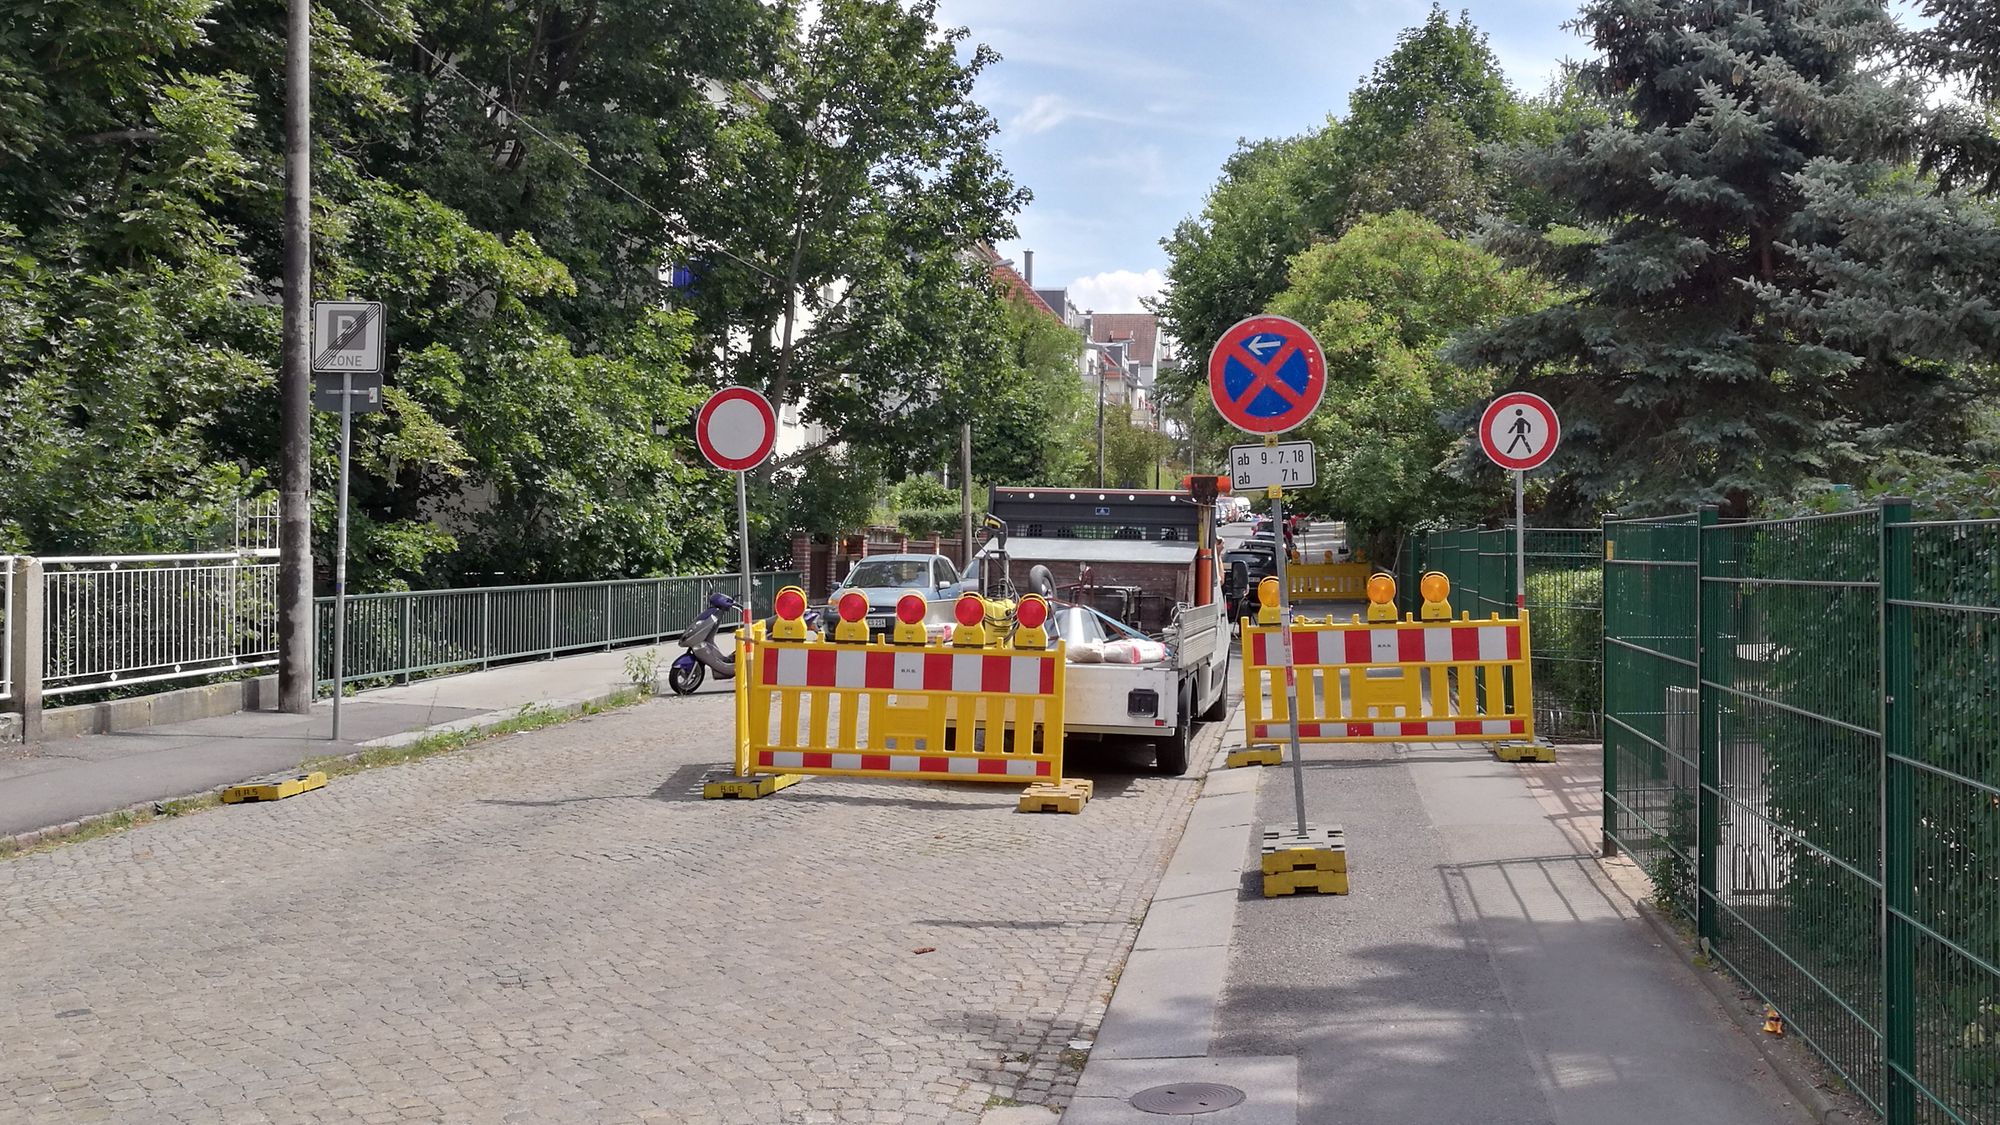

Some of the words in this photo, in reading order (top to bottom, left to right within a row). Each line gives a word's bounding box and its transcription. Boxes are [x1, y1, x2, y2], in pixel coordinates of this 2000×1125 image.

[337, 315, 356, 345] P
[330, 355, 362, 367] ZONE
[1237, 453, 1250, 466] ab
[1238, 472, 1250, 485] ab
